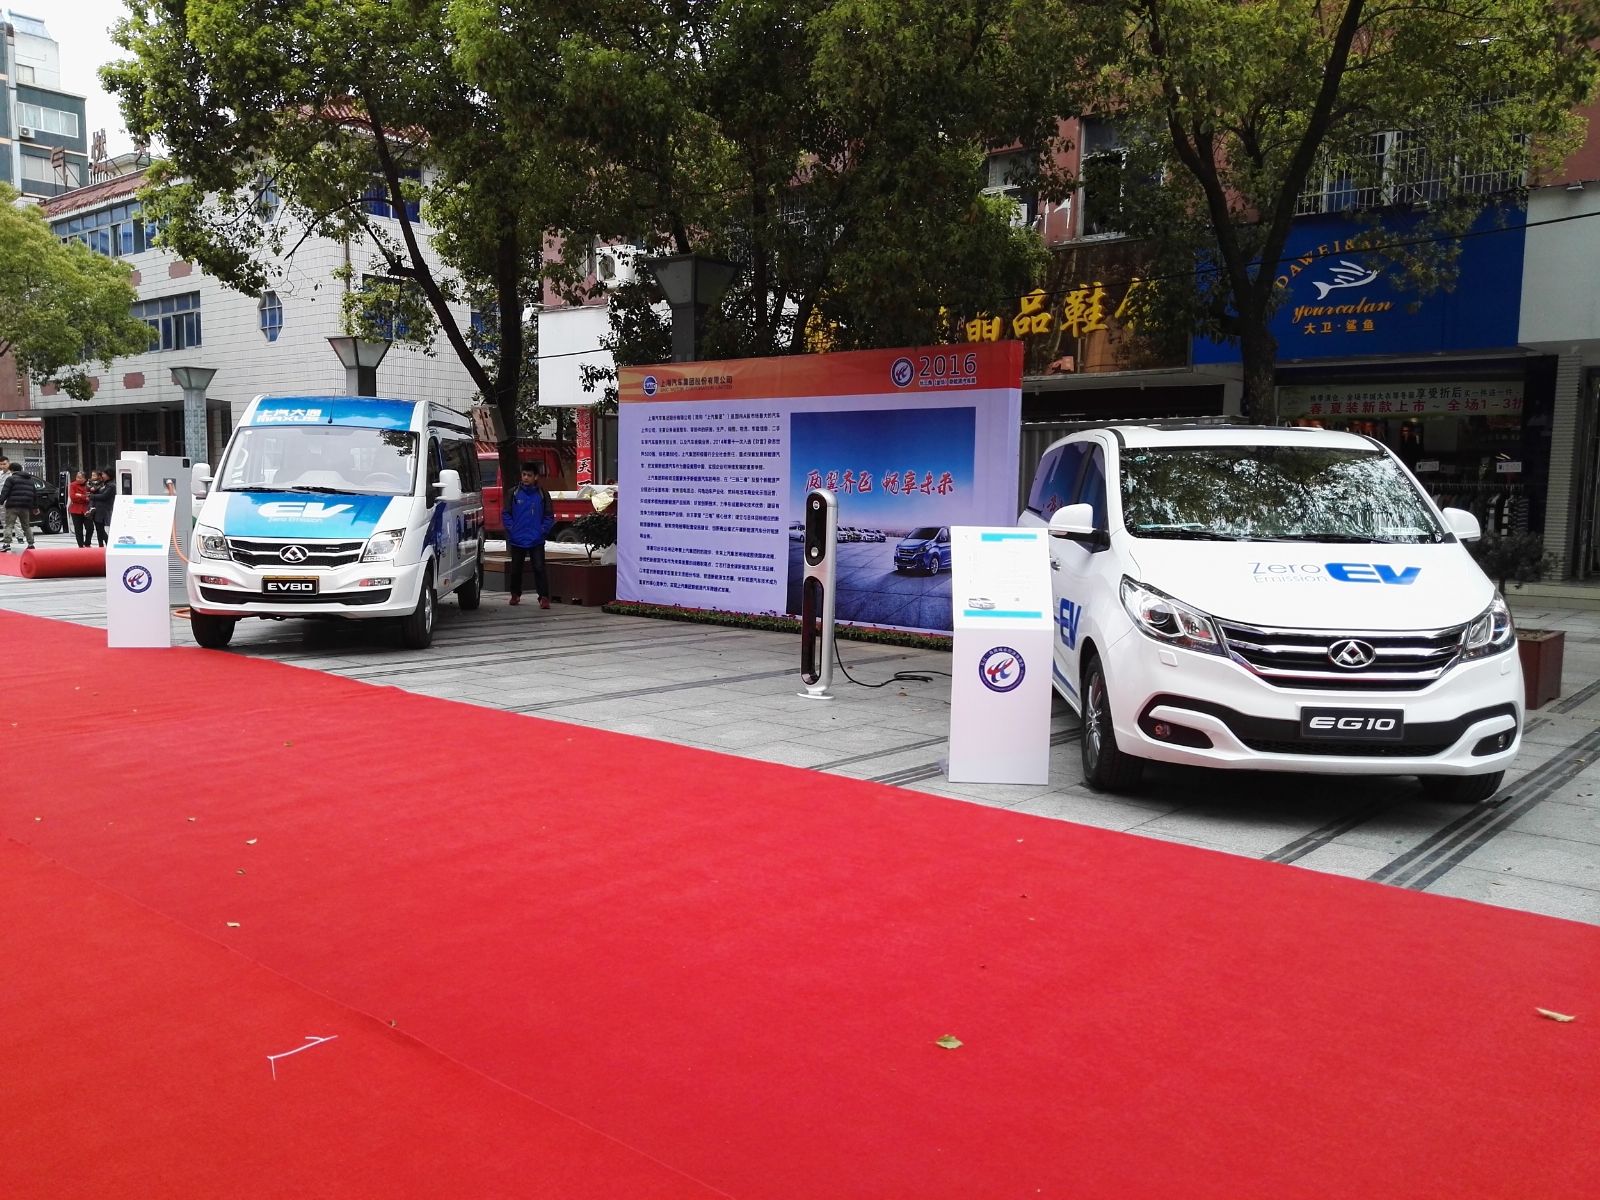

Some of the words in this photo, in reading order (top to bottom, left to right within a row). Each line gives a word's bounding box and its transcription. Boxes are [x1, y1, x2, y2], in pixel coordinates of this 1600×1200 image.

[919, 353, 977, 377] 2016
[660, 376, 733, 387] 上海汽车集团股份有限公司
[804, 468, 873, 495] 两翼齐飞
[881, 468, 955, 495] 畅享未来
[258, 501, 354, 518] EV
[1248, 562, 1321, 575] Zero
[1324, 562, 1422, 585] EV
[267, 582, 313, 591] EV80
[1254, 575, 1328, 584] Emission
[1060, 597, 1081, 651] EV
[1309, 716, 1395, 731] EG10
